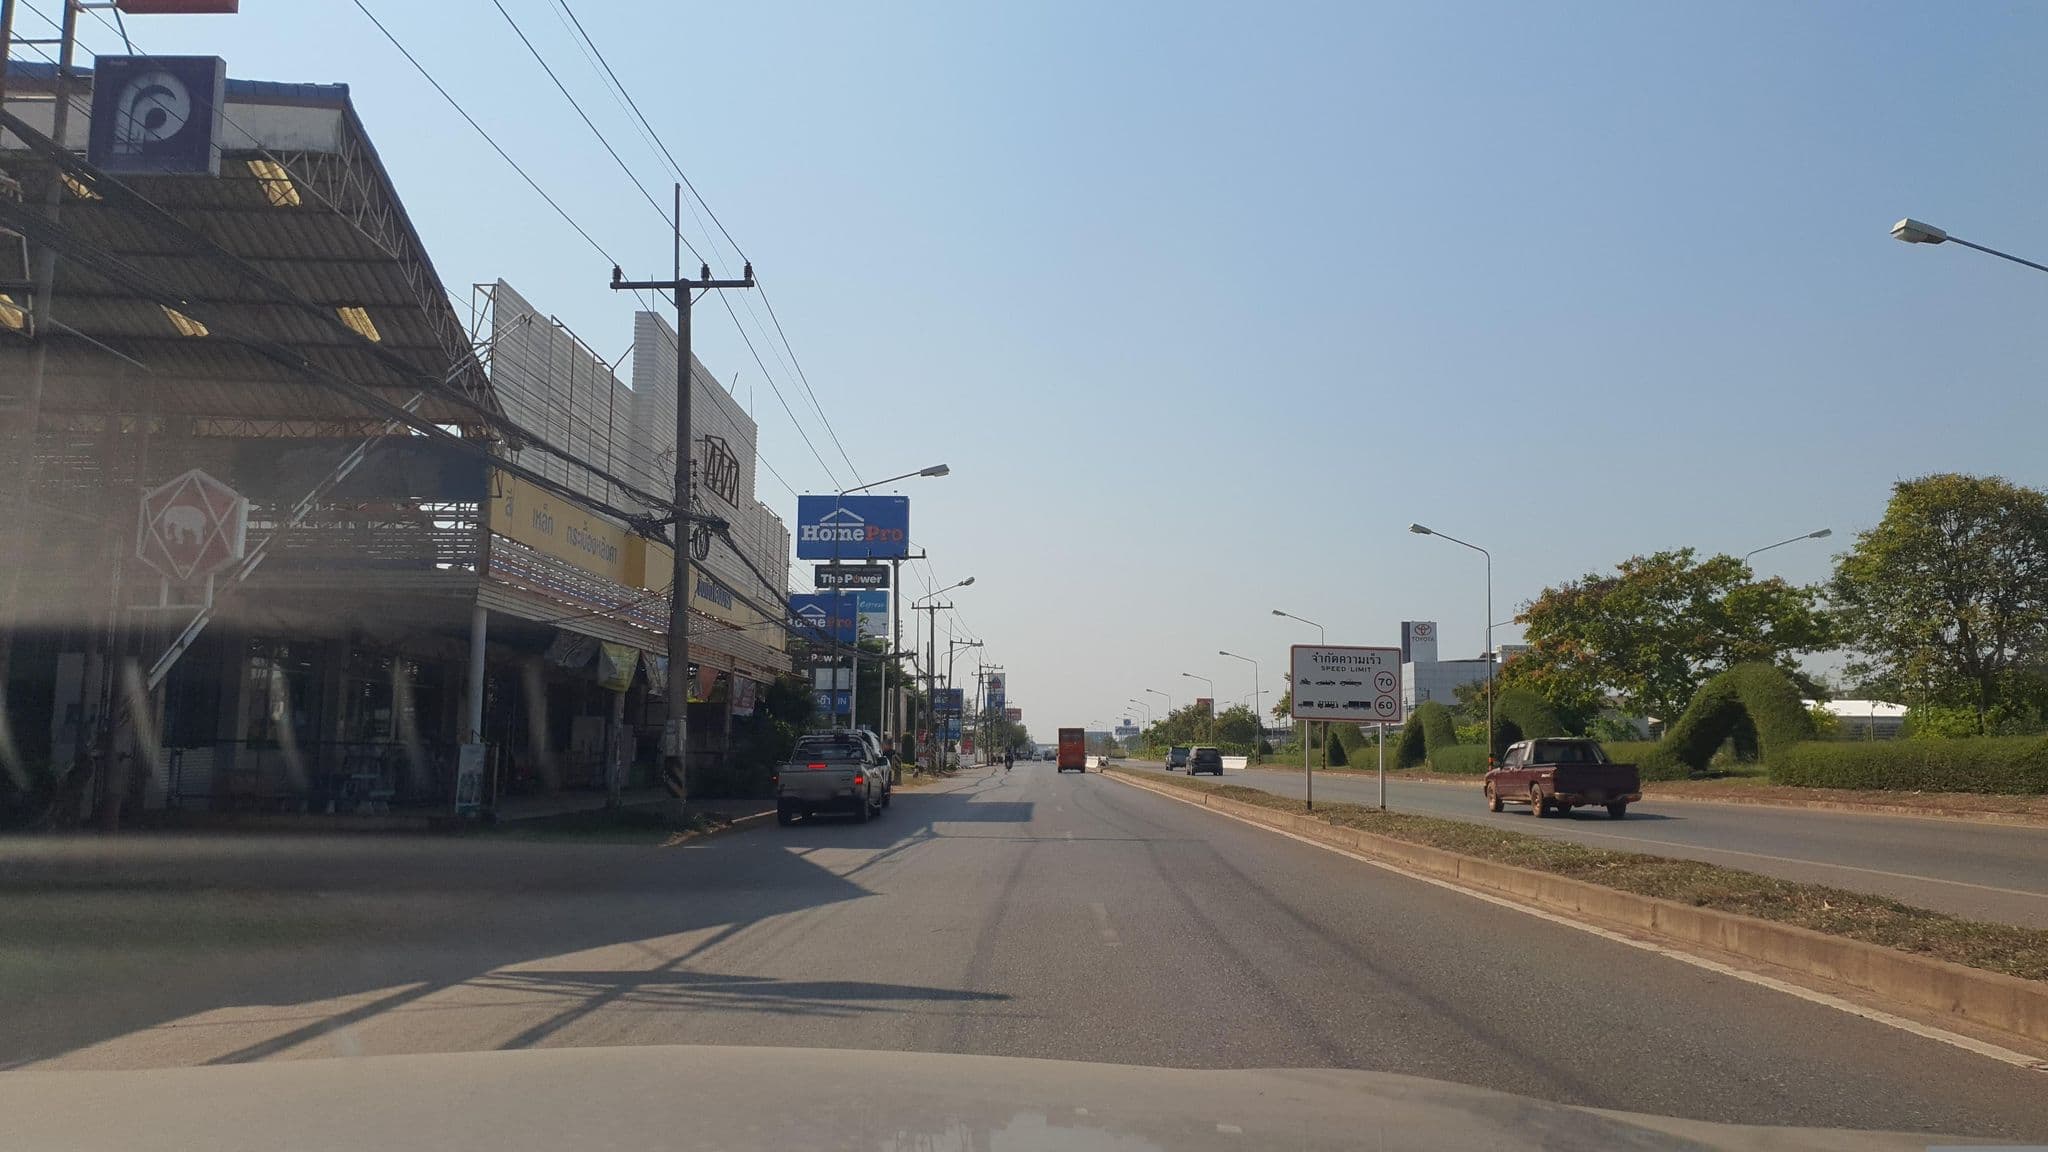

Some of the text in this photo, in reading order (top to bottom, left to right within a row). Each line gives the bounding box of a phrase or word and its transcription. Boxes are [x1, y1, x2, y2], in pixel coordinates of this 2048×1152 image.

[801, 524, 903, 542] HomePro
[1312, 651, 1381, 665] จำกัดความเร็ว
[1378, 677, 1392, 687] 70
[836, 696, 847, 705] IN
[1378, 700, 1392, 710] 60
